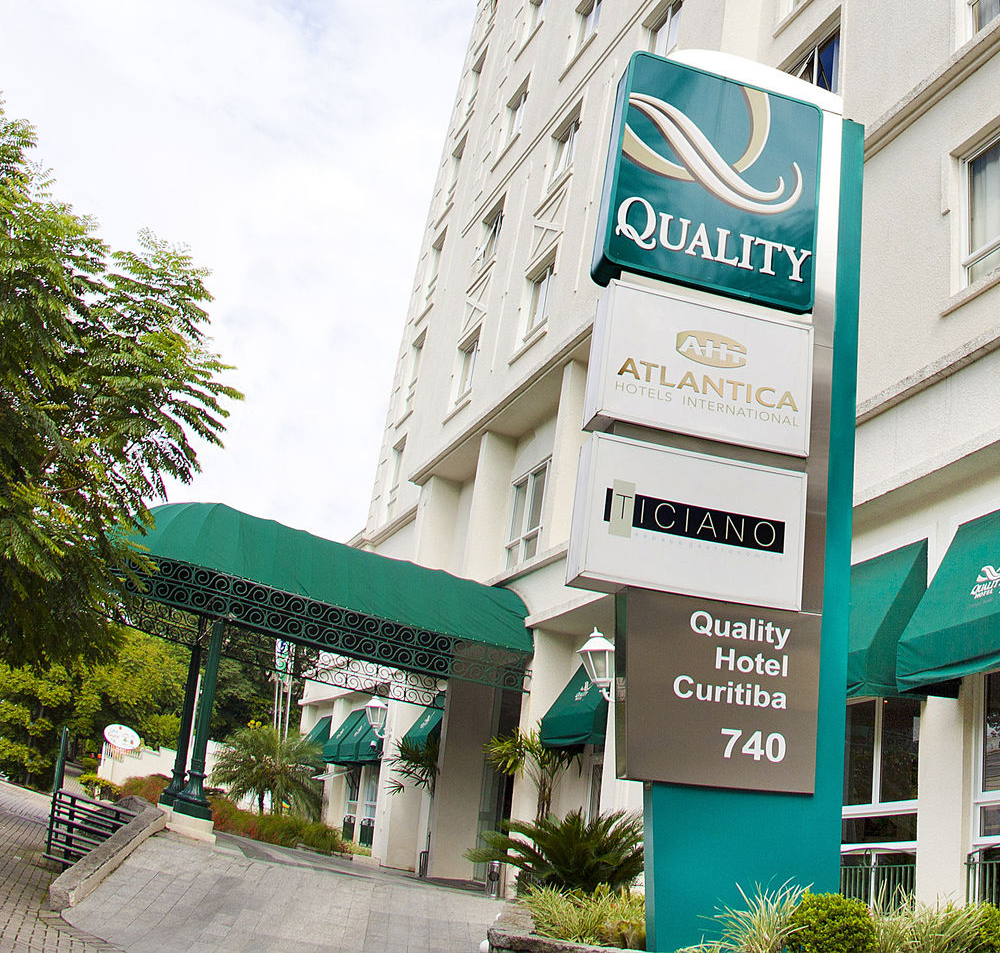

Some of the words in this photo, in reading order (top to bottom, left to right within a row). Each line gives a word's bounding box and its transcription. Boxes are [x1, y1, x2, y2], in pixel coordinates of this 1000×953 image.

[615, 196, 812, 283] QUALITY
[615, 380, 673, 403] HOTELS
[682, 395, 800, 427] INTERNATIONAL
[617, 357, 799, 412] ATLANTICA
[615, 493, 776, 547] TICIANO
[690, 610, 791, 650] Quality
[715, 646, 789, 677] Hotel
[673, 675, 787, 710] Curitiba
[720, 728, 787, 763] 740
